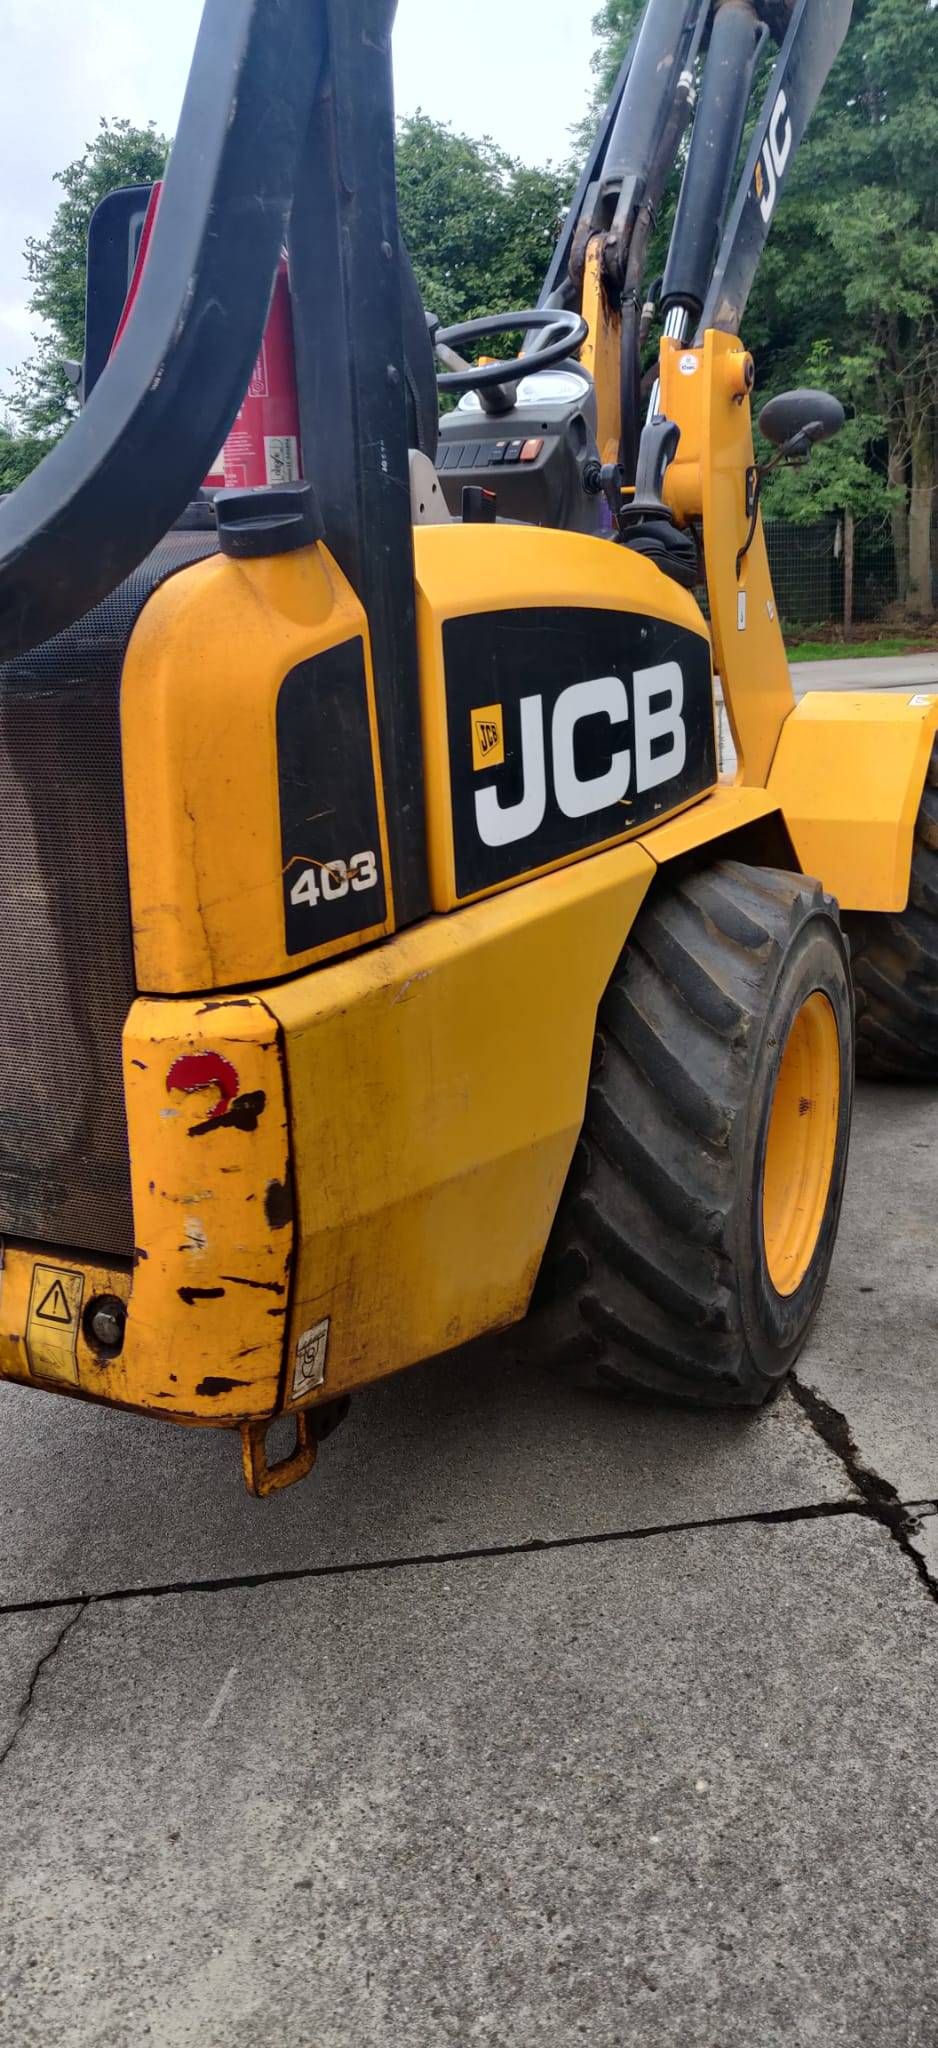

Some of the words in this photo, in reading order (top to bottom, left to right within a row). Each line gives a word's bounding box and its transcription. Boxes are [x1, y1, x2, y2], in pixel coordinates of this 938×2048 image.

[474, 661, 686, 847] JCB
[480, 721, 498, 751] JCB
[290, 850, 378, 907] 403
